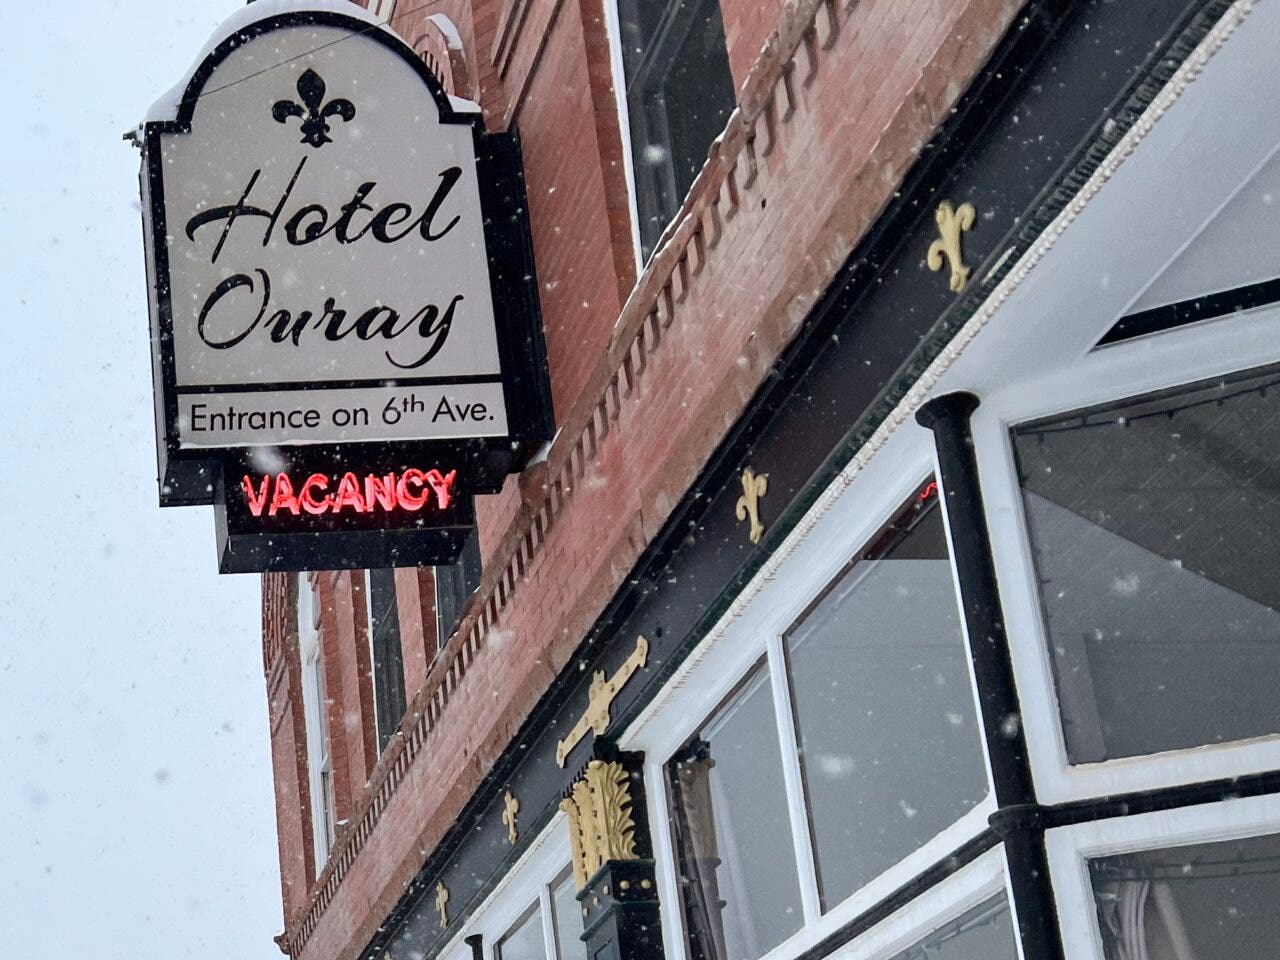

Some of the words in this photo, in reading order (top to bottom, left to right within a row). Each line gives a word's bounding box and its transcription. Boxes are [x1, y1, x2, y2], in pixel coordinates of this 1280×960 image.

[186, 156, 463, 264] Hotel
[198, 268, 464, 369] Ouray
[191, 404, 320, 431] Entrance
[332, 407, 369, 426] on
[382, 394, 425, 425] 6th
[431, 395, 495, 423] Ave.
[240, 468, 456, 516] VACANCY
